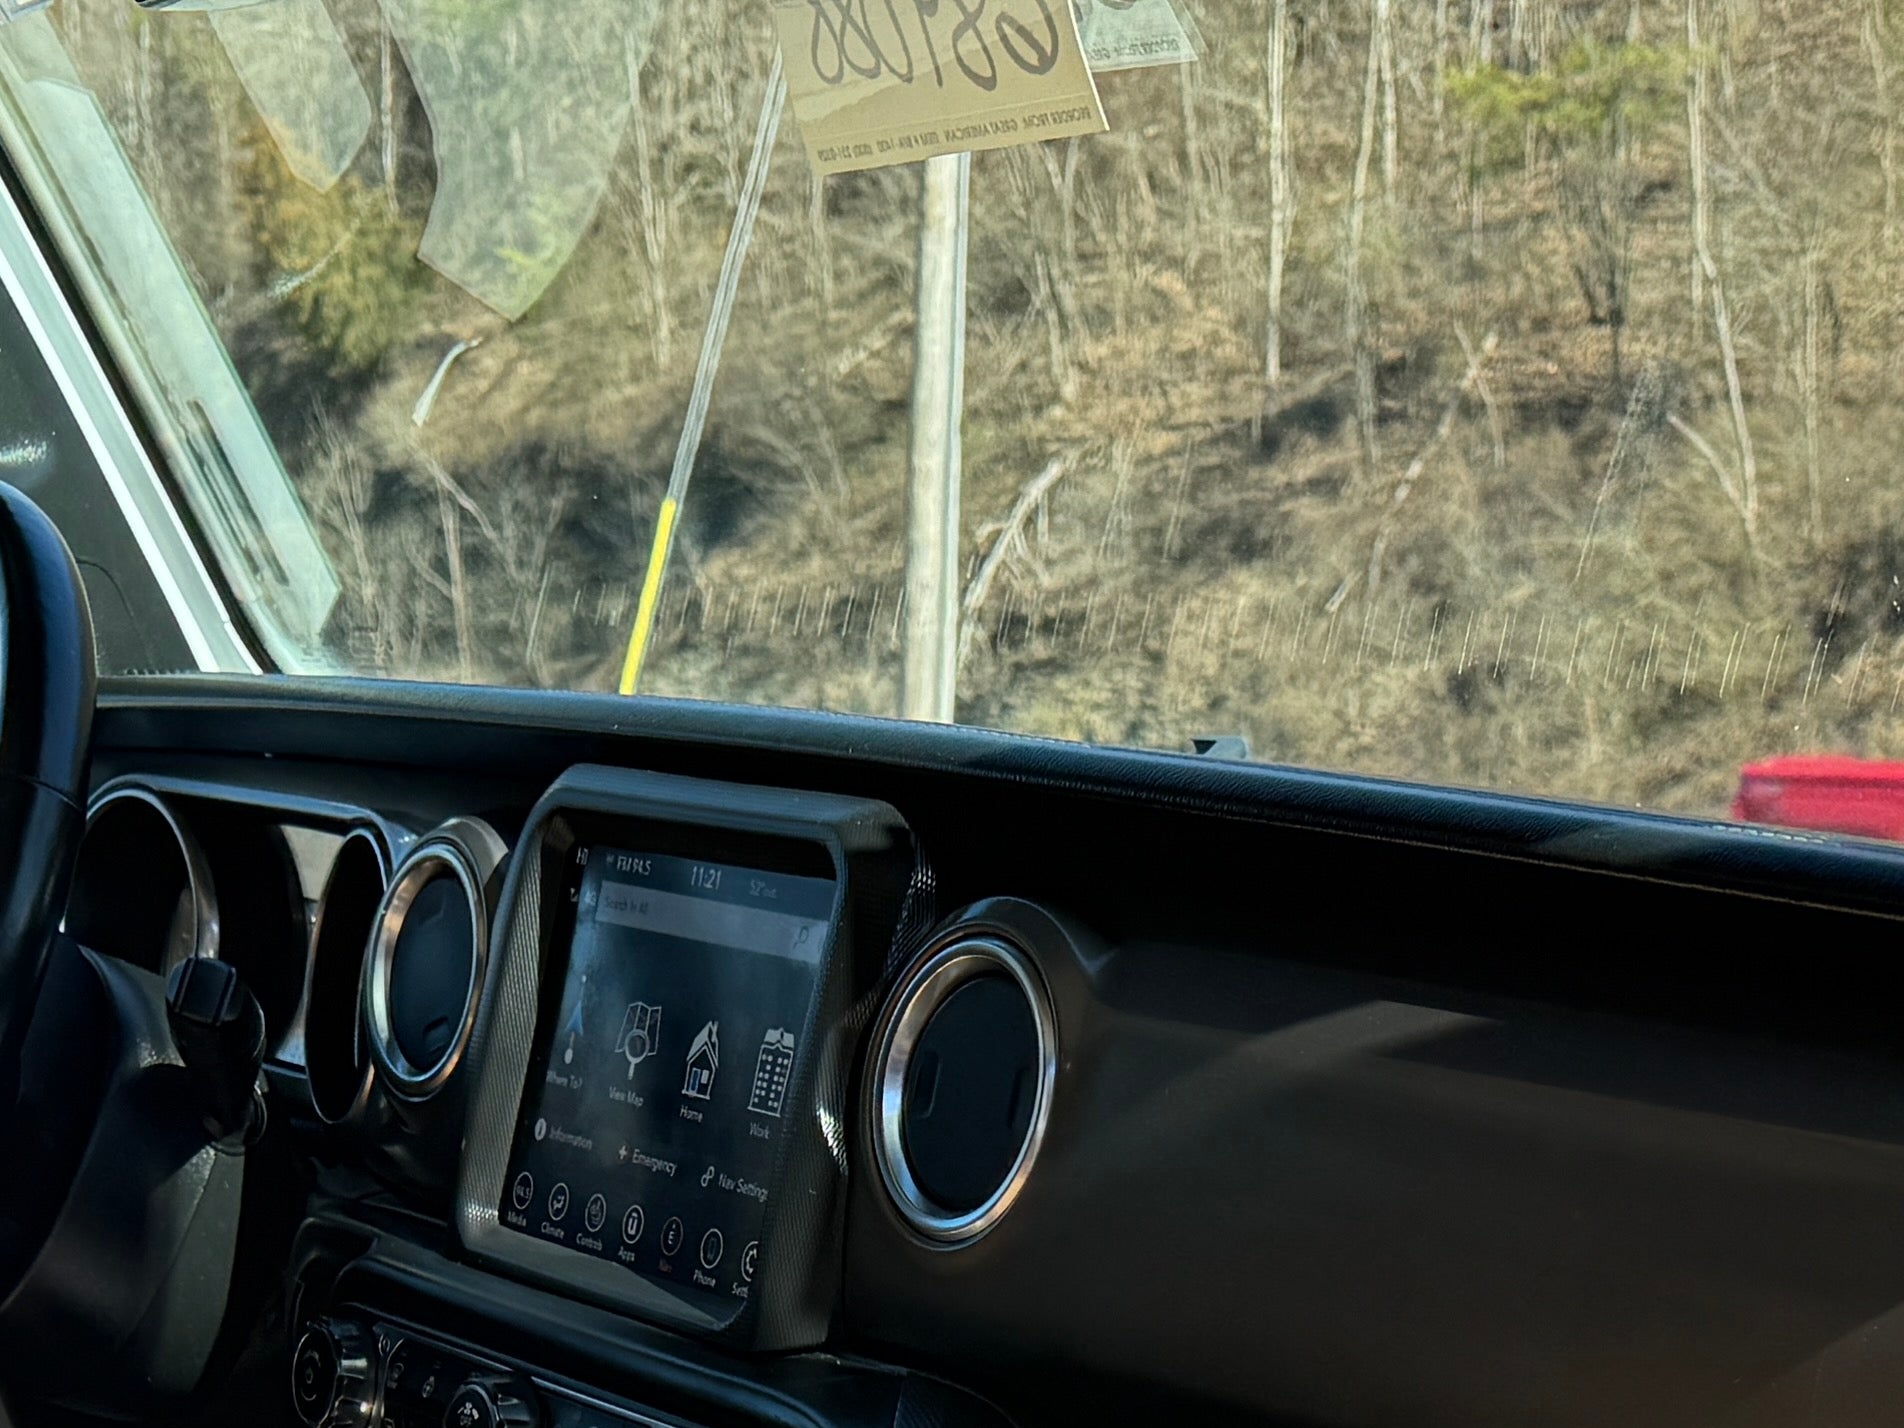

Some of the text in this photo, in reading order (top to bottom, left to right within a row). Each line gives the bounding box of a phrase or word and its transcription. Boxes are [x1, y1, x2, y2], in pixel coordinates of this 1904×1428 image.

[691, 866, 722, 890] 11:21
[680, 1104, 703, 1123] Home
[749, 1122, 769, 1139] Work
[632, 1148, 677, 1177] Emergency
[617, 1246, 636, 1263] Apps
[692, 1268, 717, 1289] Phone
